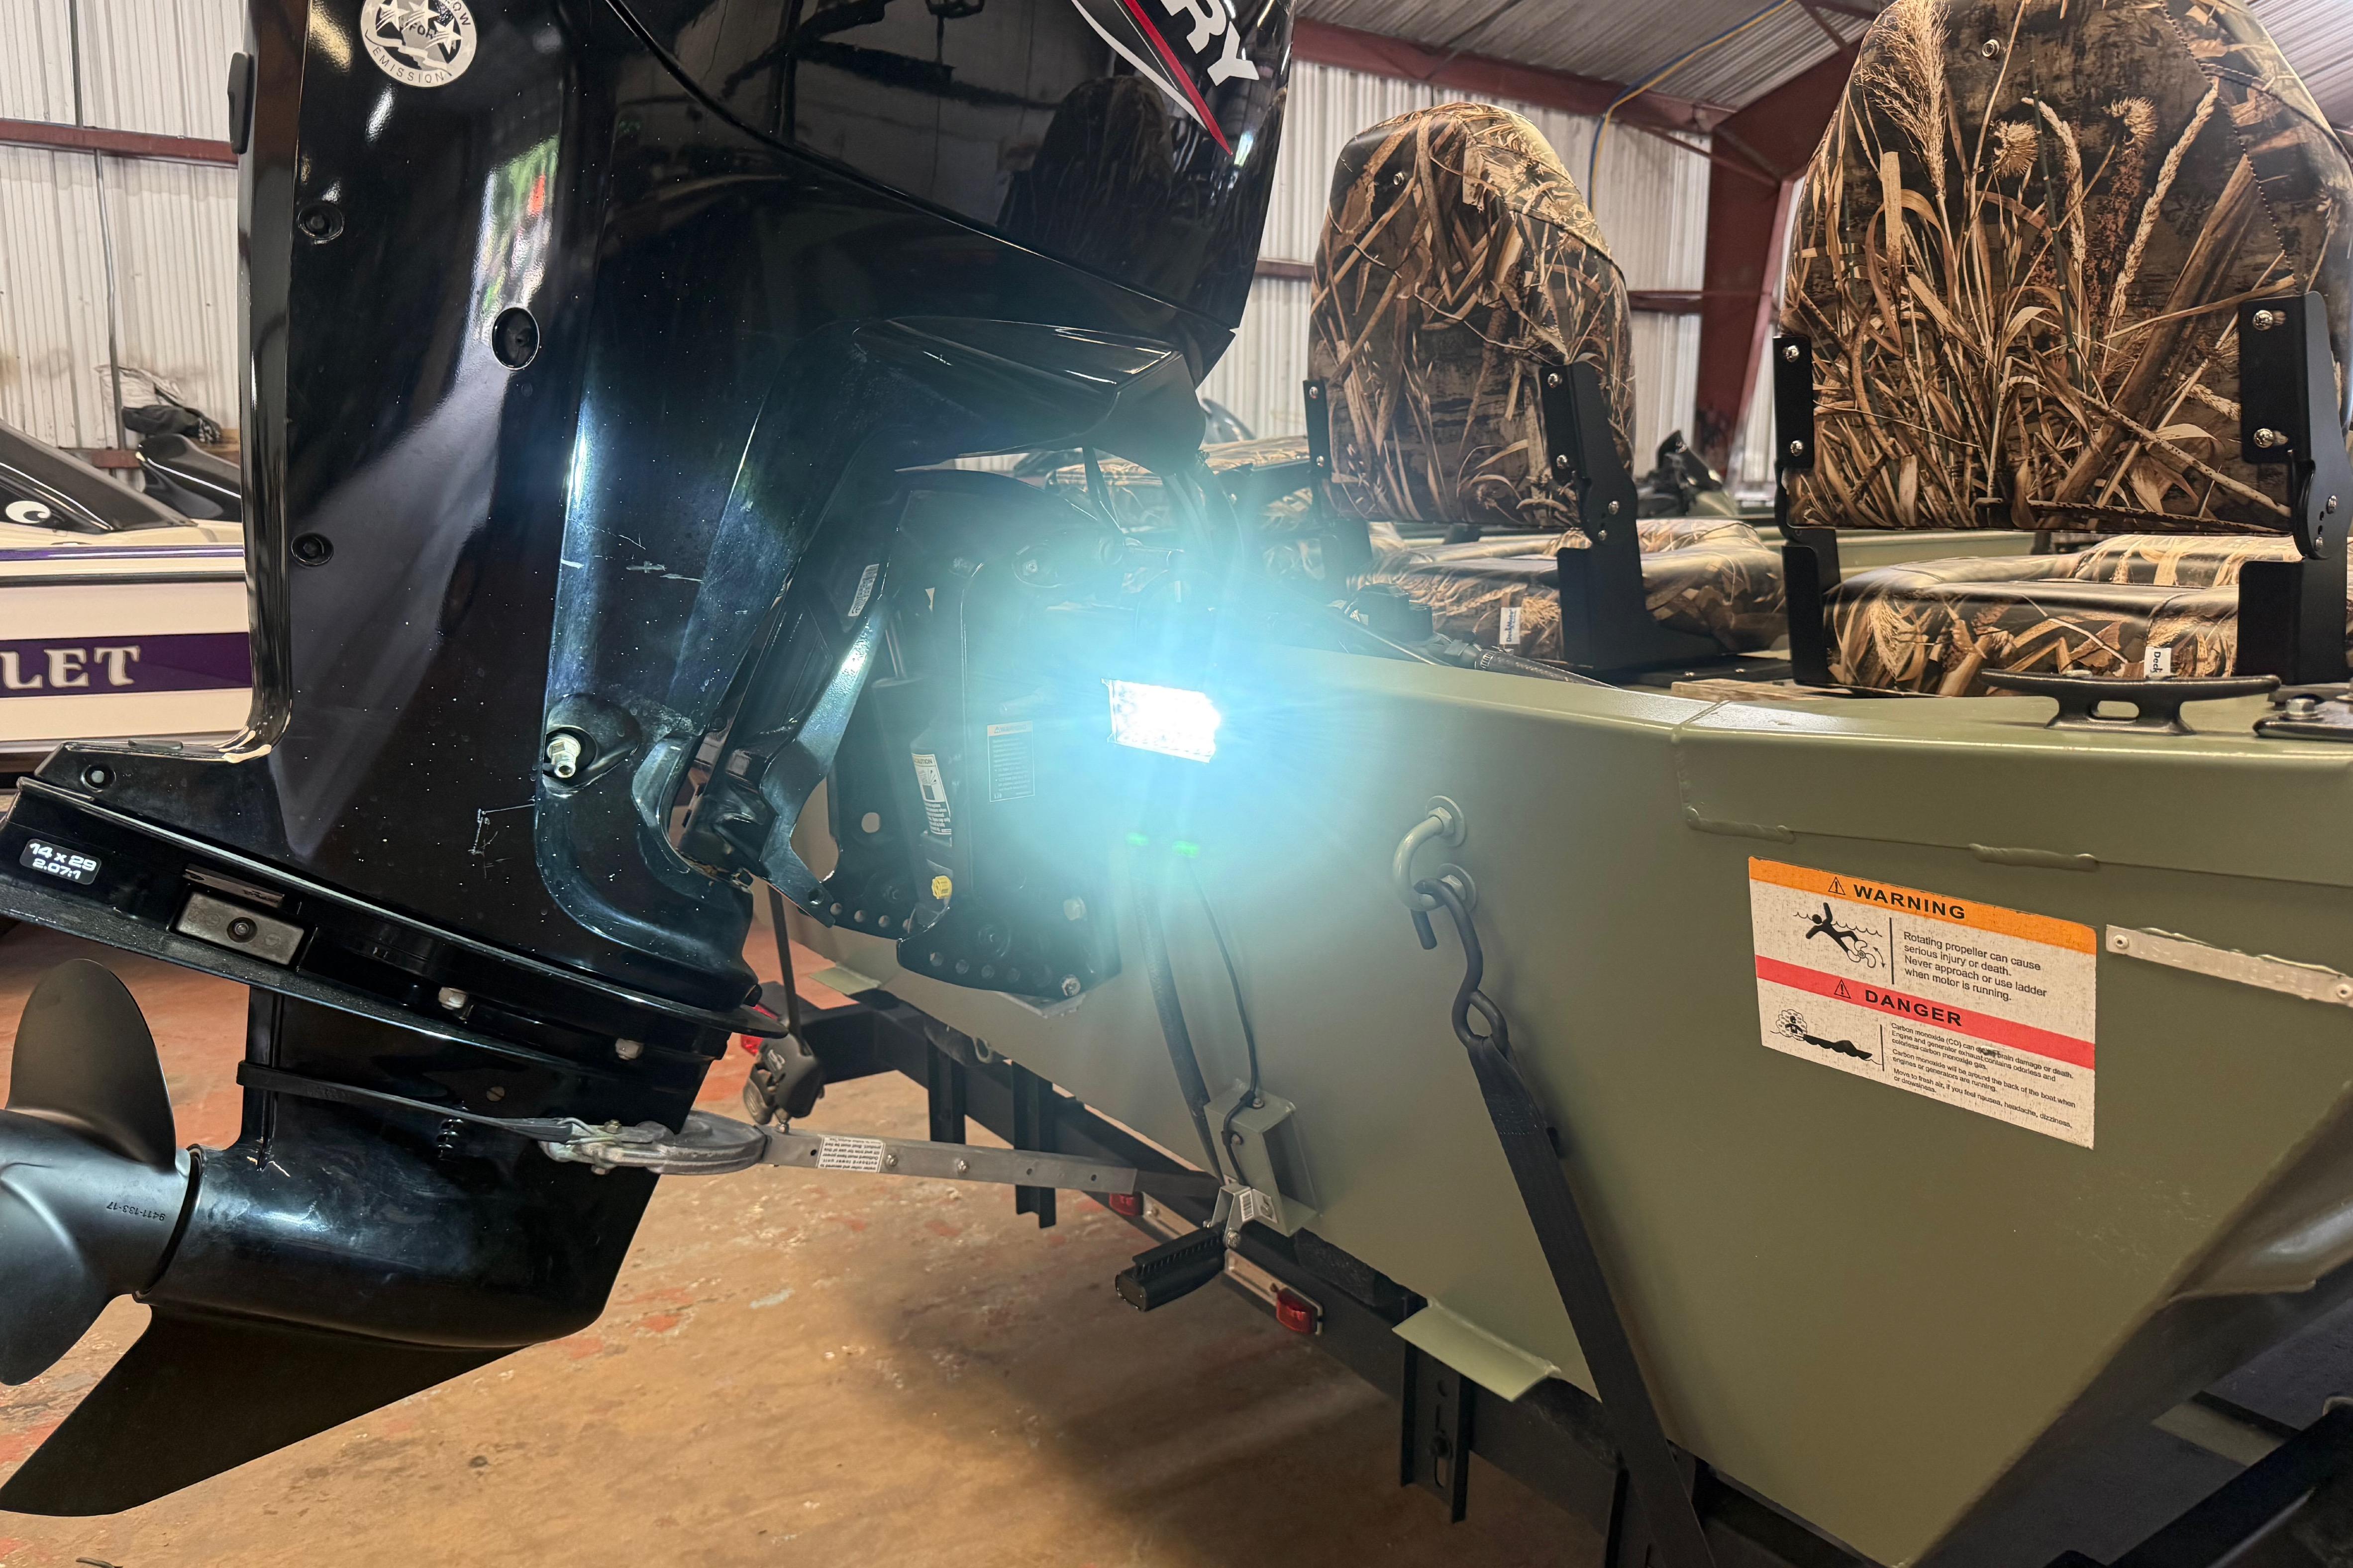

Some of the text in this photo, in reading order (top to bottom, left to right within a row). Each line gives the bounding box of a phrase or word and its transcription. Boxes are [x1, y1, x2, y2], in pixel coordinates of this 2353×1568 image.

[373, 47, 444, 83] EMISSION
[0, 646, 140, 689] LET
[30, 843, 97, 871] 14 x 29
[32, 858, 81, 880] 2.07:1
[1853, 884, 1965, 919] WARNING
[1904, 931, 2041, 970] Rotating propeller can cause
[1904, 945, 1938, 959] serious
[1941, 952, 1966, 967] injury
[1981, 961, 2012, 976] death.
[1904, 968, 2011, 1002] when motor is running.
[1905, 955, 1933, 969] Never
[1935, 964, 1979, 980] approach
[1995, 979, 2012, 988] use
[2016, 981, 2047, 996] ladder
[1865, 989, 1962, 1026] DANGER
[1891, 1023, 1913, 1034] Carbon
[1915, 1030, 1944, 1042] monoxide
[1946, 1038, 1961, 1048] (CO)
[2015, 1058, 2042, 1070] damage
[2052, 1068, 2073, 1078] death.
[1892, 1038, 1919, 1050] colorless
[1920, 1046, 1941, 1056] carbon
[1943, 1053, 1972, 1065] monoxide
[1892, 1030, 1913, 1040] Engine
[1927, 1041, 1957, 1053] generator
[1958, 1050, 1983, 1061] exhaust
[1984, 1058, 2011, 1069] contains
[2013, 1066, 2041, 1077] odorless
[1893, 1057, 1916, 1068] engines
[1926, 1067, 1958, 1080] generators
[1893, 1049, 1915, 1060] Carbon
[1916, 1056, 1945, 1069] monoxide
[1968, 1072, 1990, 1082] around
[2003, 1080, 2019, 1090] back
[2029, 1088, 2039, 1096] the
[2041, 1092, 2056, 1102] boat
[2057, 1097, 2075, 1108] when
[1893, 1068, 1910, 1077] Move
[1919, 1076, 1934, 1085] fresh
[1951, 1085, 1963, 1094] you
[1964, 1089, 1975, 1097] feel
[1977, 1094, 2002, 1106] nausea,
[2004, 1101, 2038, 1118] headache,
[2040, 1113, 2072, 1128] dizziness,
